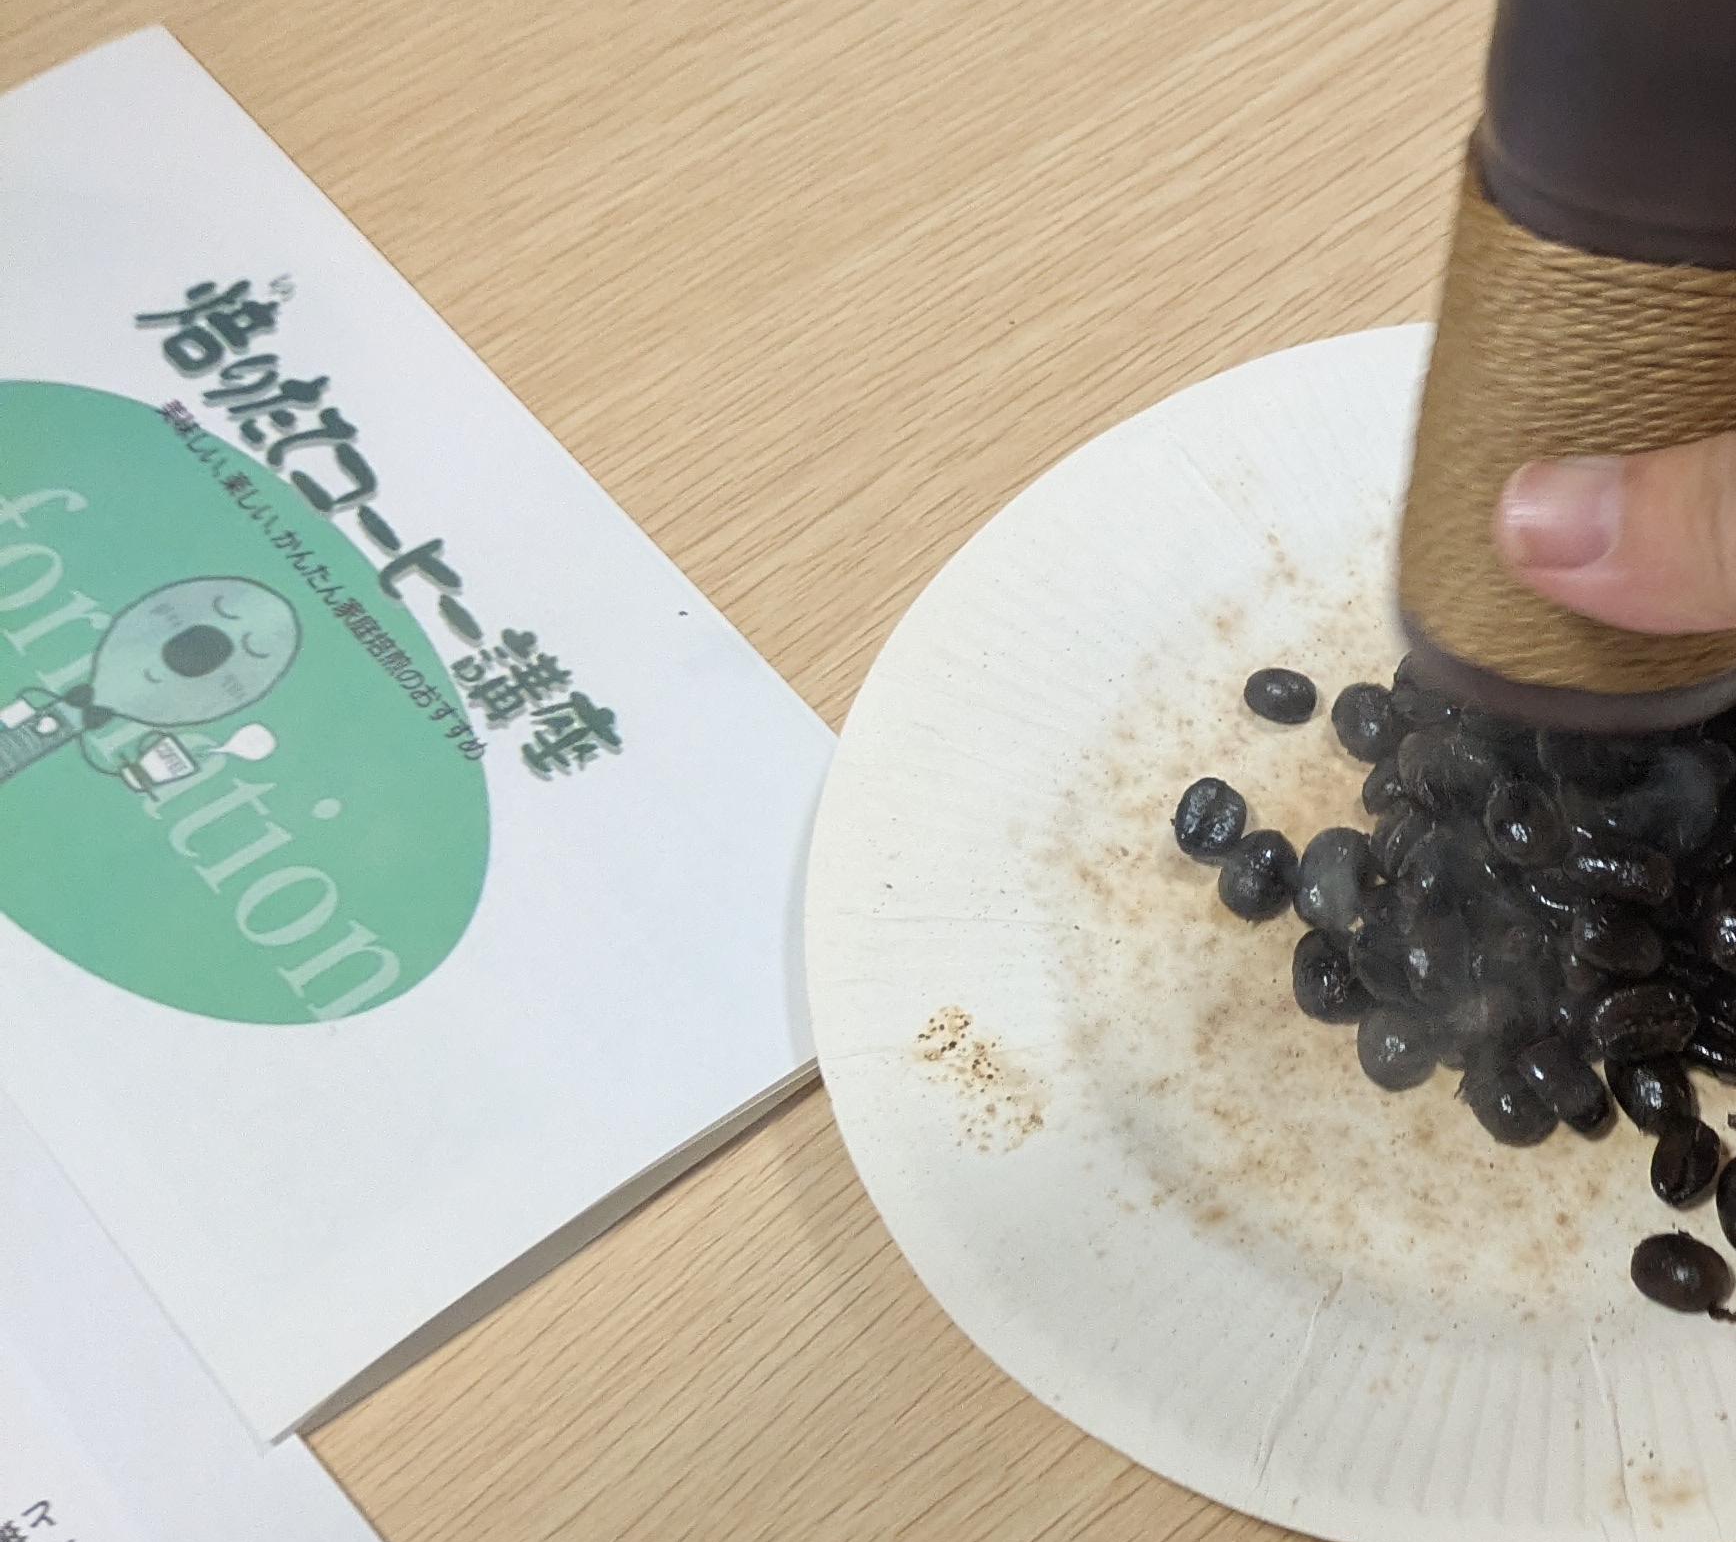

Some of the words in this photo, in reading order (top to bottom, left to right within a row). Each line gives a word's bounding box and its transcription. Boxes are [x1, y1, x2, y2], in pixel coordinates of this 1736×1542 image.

[134, 280, 624, 781] 焙りたてコーヒー講座
